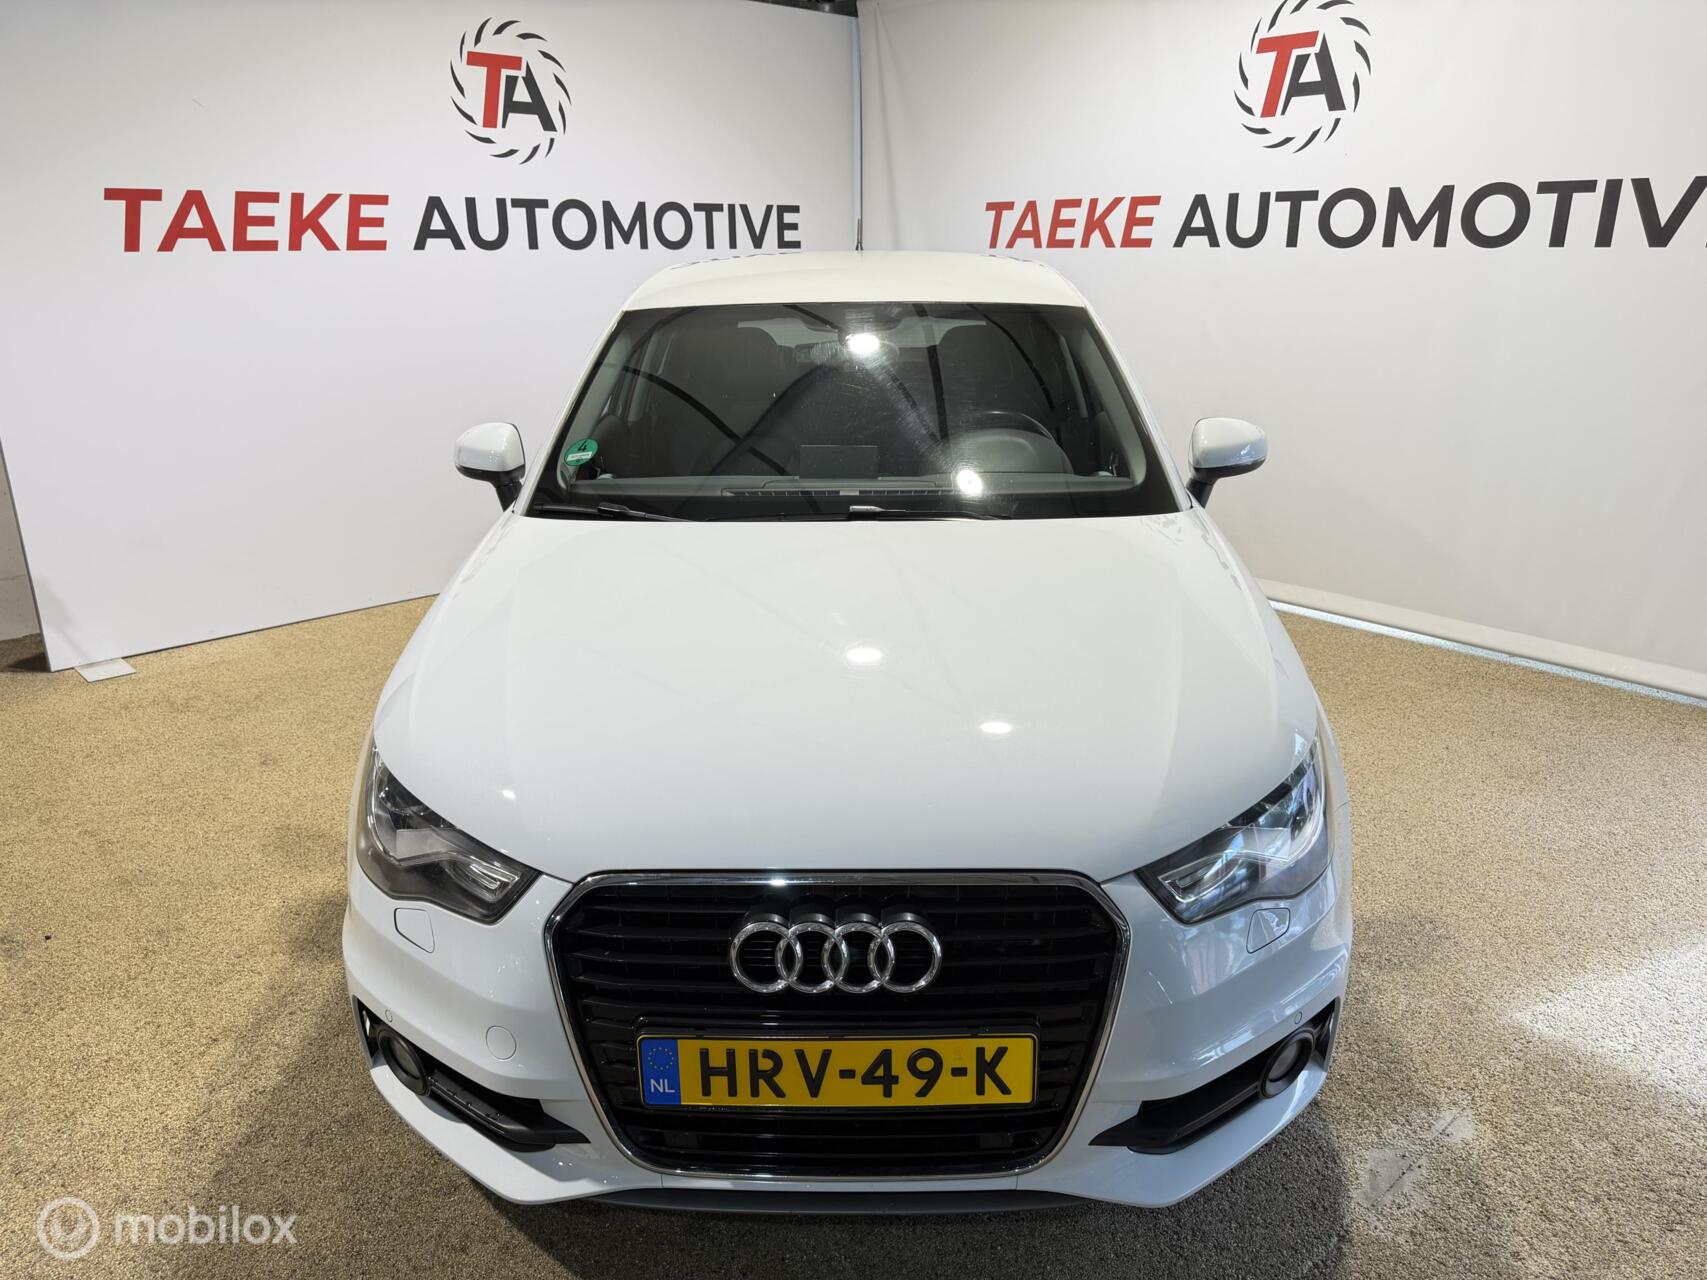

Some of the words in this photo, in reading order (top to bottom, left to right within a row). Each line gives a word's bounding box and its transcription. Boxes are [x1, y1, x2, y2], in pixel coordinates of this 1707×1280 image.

[466, 51, 557, 132] TA
[1255, 30, 1346, 118] TA
[104, 187, 389, 252] TAEKE
[413, 195, 802, 250] AUTOMOTIVE
[985, 195, 1162, 249] TAEKE
[1173, 175, 1707, 249] AUTOMOTIV
[650, 1078, 676, 1094] NL
[699, 1046, 1012, 1098] HRV-49-K
